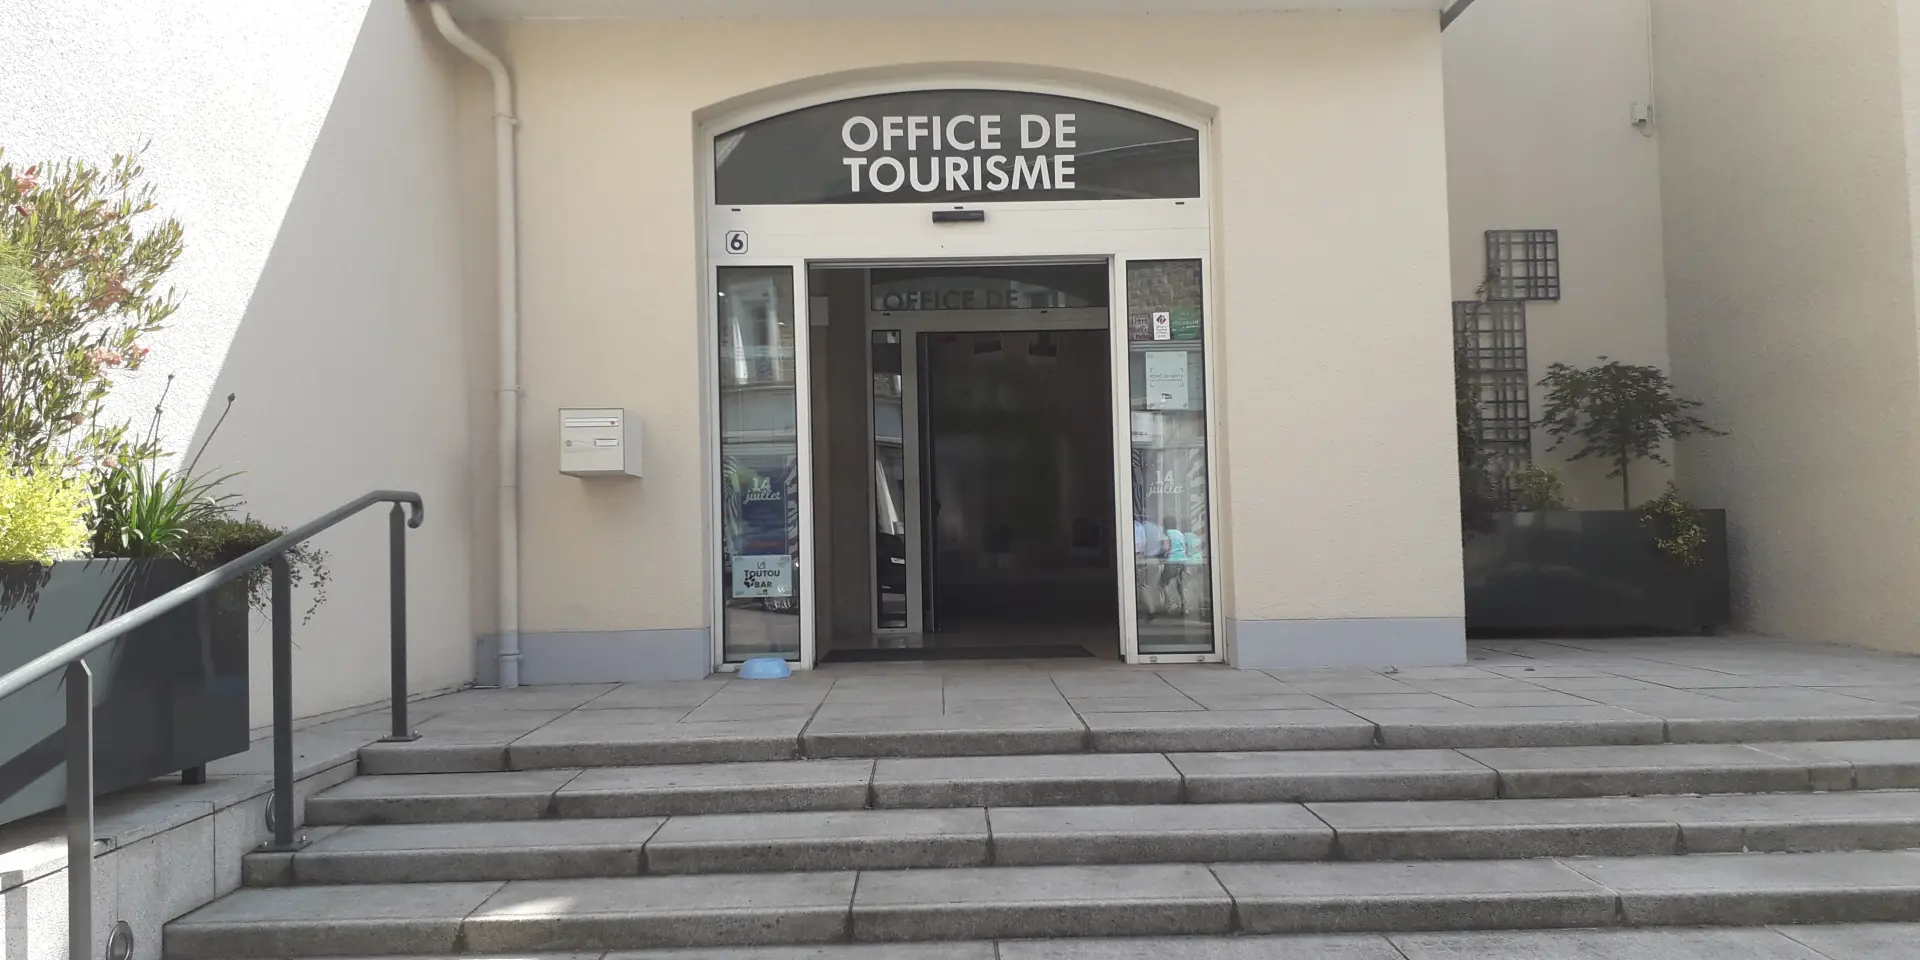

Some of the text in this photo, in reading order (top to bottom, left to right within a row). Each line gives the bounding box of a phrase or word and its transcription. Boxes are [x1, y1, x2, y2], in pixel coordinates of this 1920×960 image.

[841, 113, 1077, 152] OFFICE DE
[842, 154, 1076, 193] TOURISME
[730, 233, 744, 251] 6
[883, 290, 975, 310] OFFICE
[752, 476, 772, 492] 14
[1156, 470, 1175, 485] 14
[742, 490, 781, 504] juillet
[744, 569, 781, 578] TOUTOU
[754, 581, 773, 589] BAR
